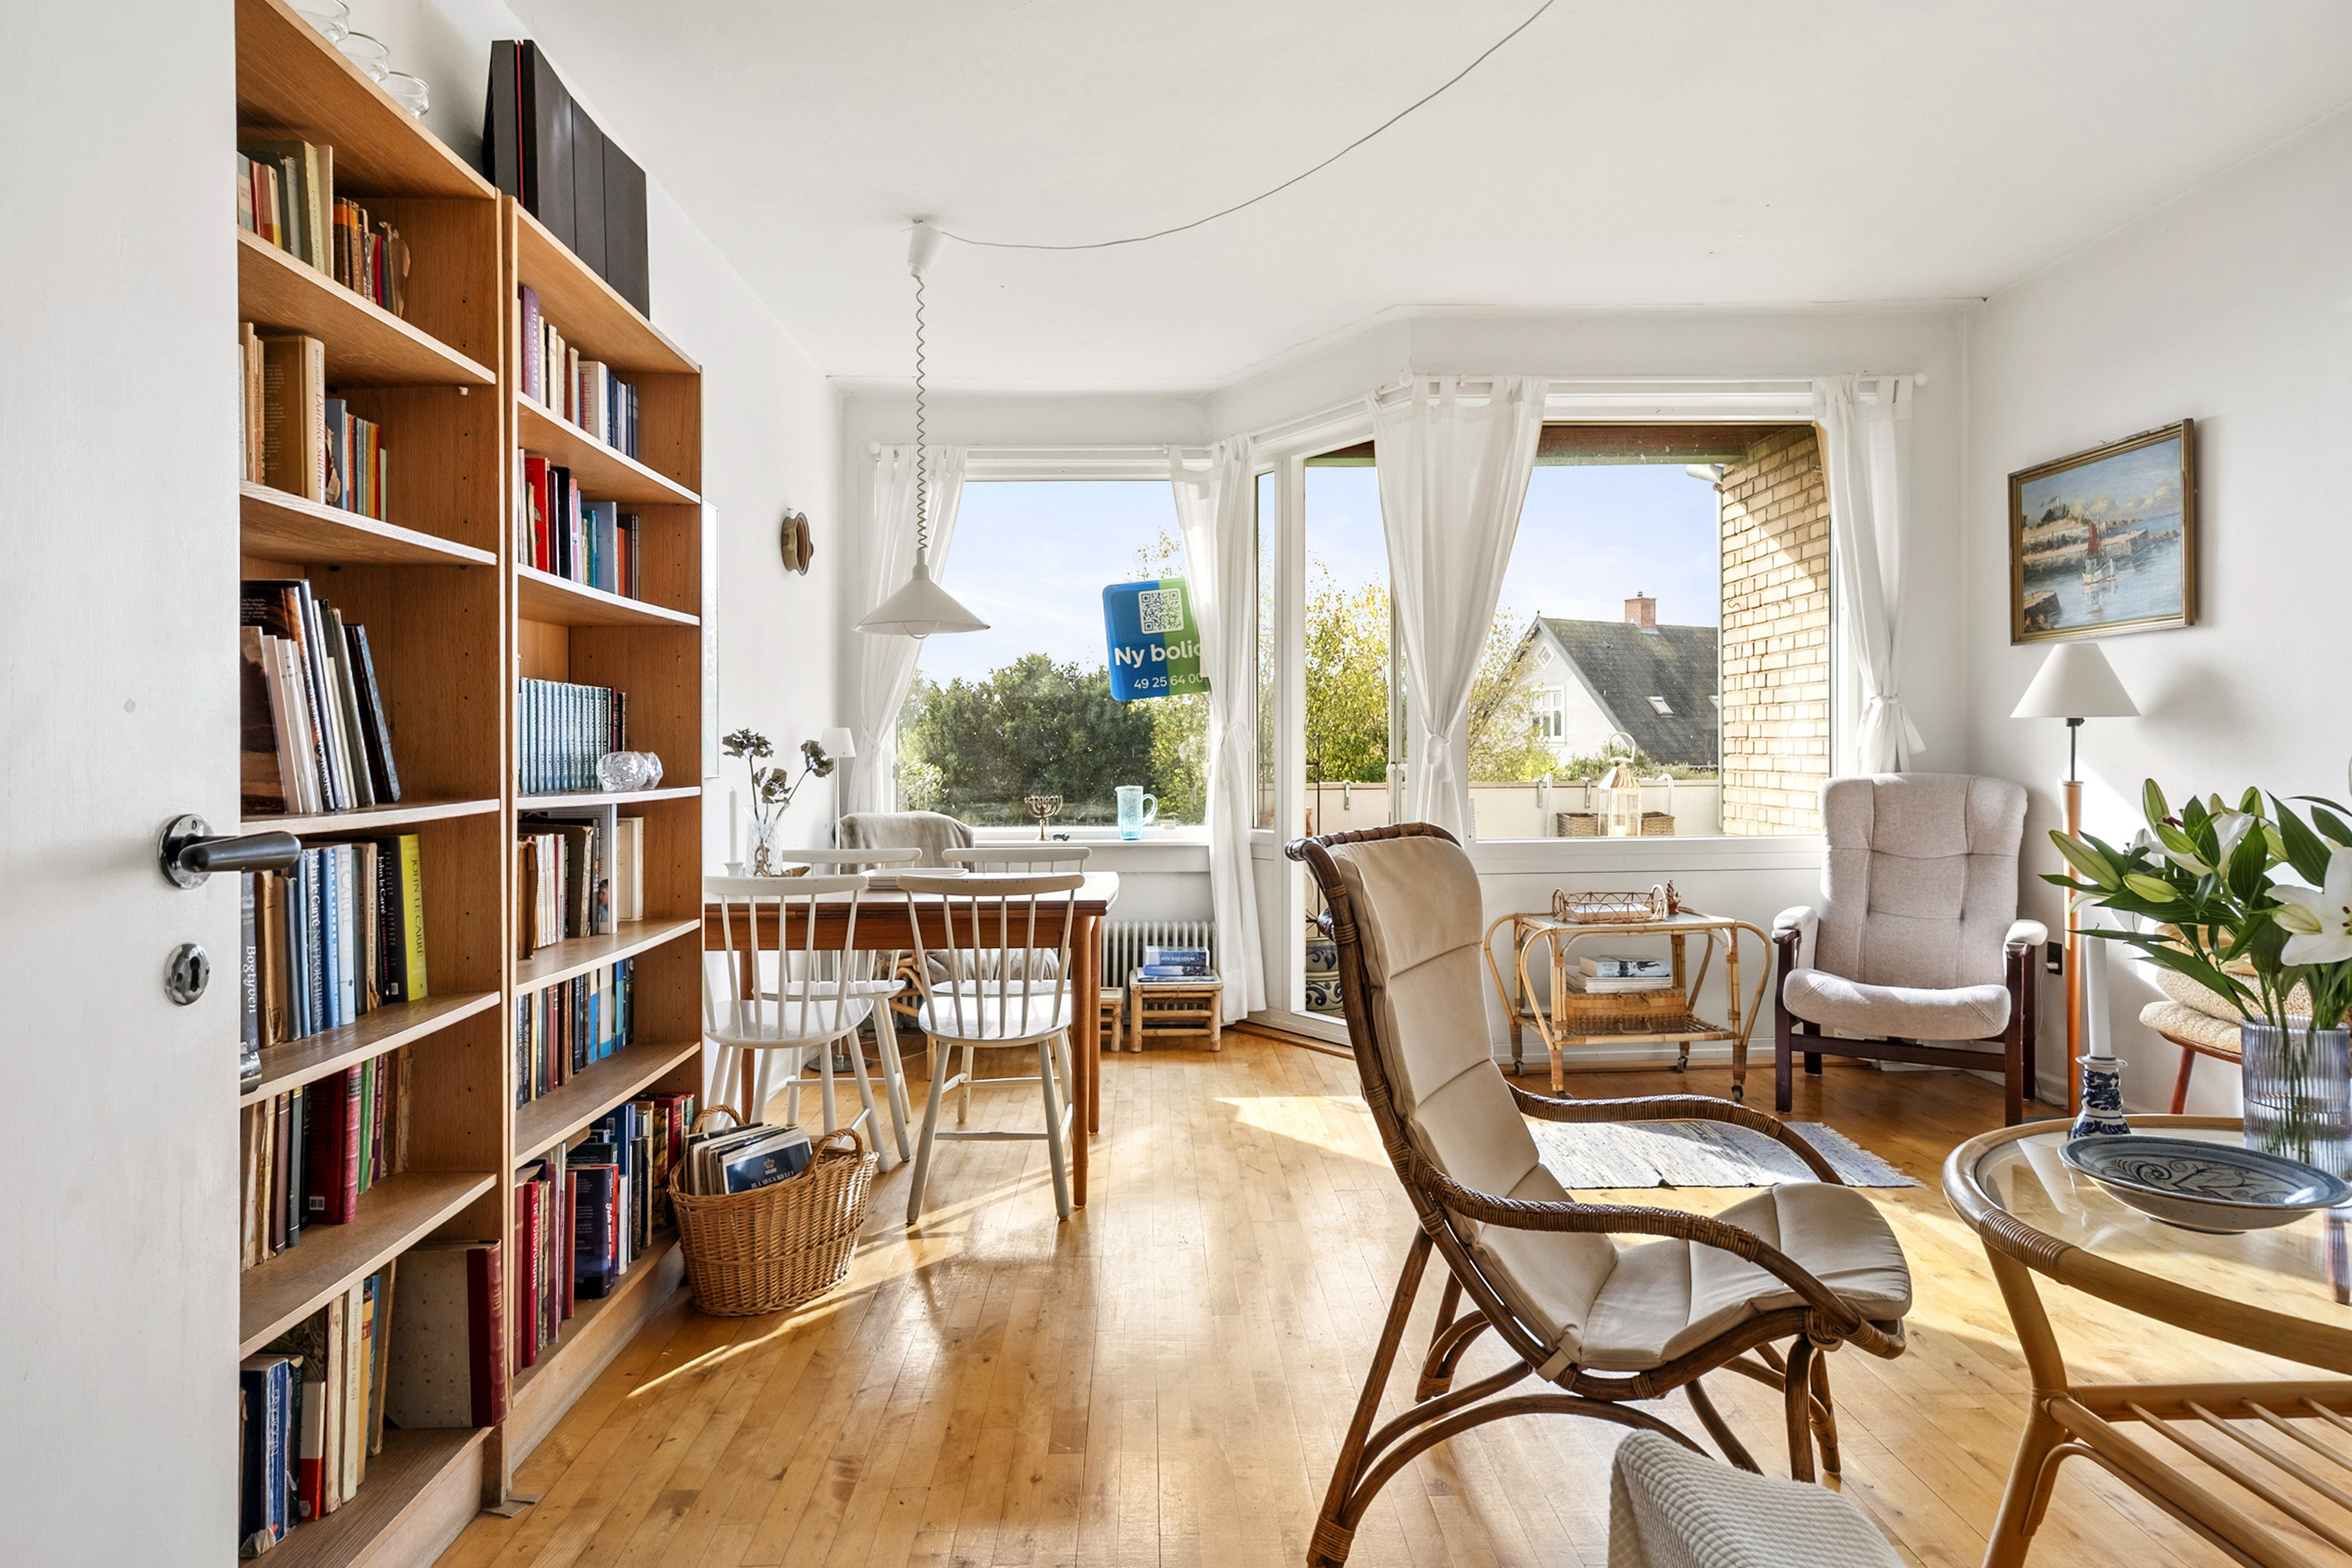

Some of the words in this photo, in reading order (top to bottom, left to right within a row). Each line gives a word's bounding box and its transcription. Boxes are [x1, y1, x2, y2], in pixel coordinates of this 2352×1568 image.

[315, 392, 325, 442] Danske
[1114, 646, 1145, 668] Ny
[1134, 678, 1149, 689] 49
[1152, 677, 1167, 688] 25
[1170, 674, 1185, 685] 64
[1188, 673, 1203, 684] 00
[309, 854, 320, 881] John
[339, 851, 350, 868] LE
[379, 879, 385, 887] le
[411, 859, 420, 892] JOHN
[310, 883, 320, 894] le
[310, 895, 321, 927] Carré
[414, 898, 421, 912] LE
[243, 946, 256, 1014] Bogtyven
[312, 930, 323, 1026] NATPORTIEREN
[533, 1203, 539, 1217] DE
